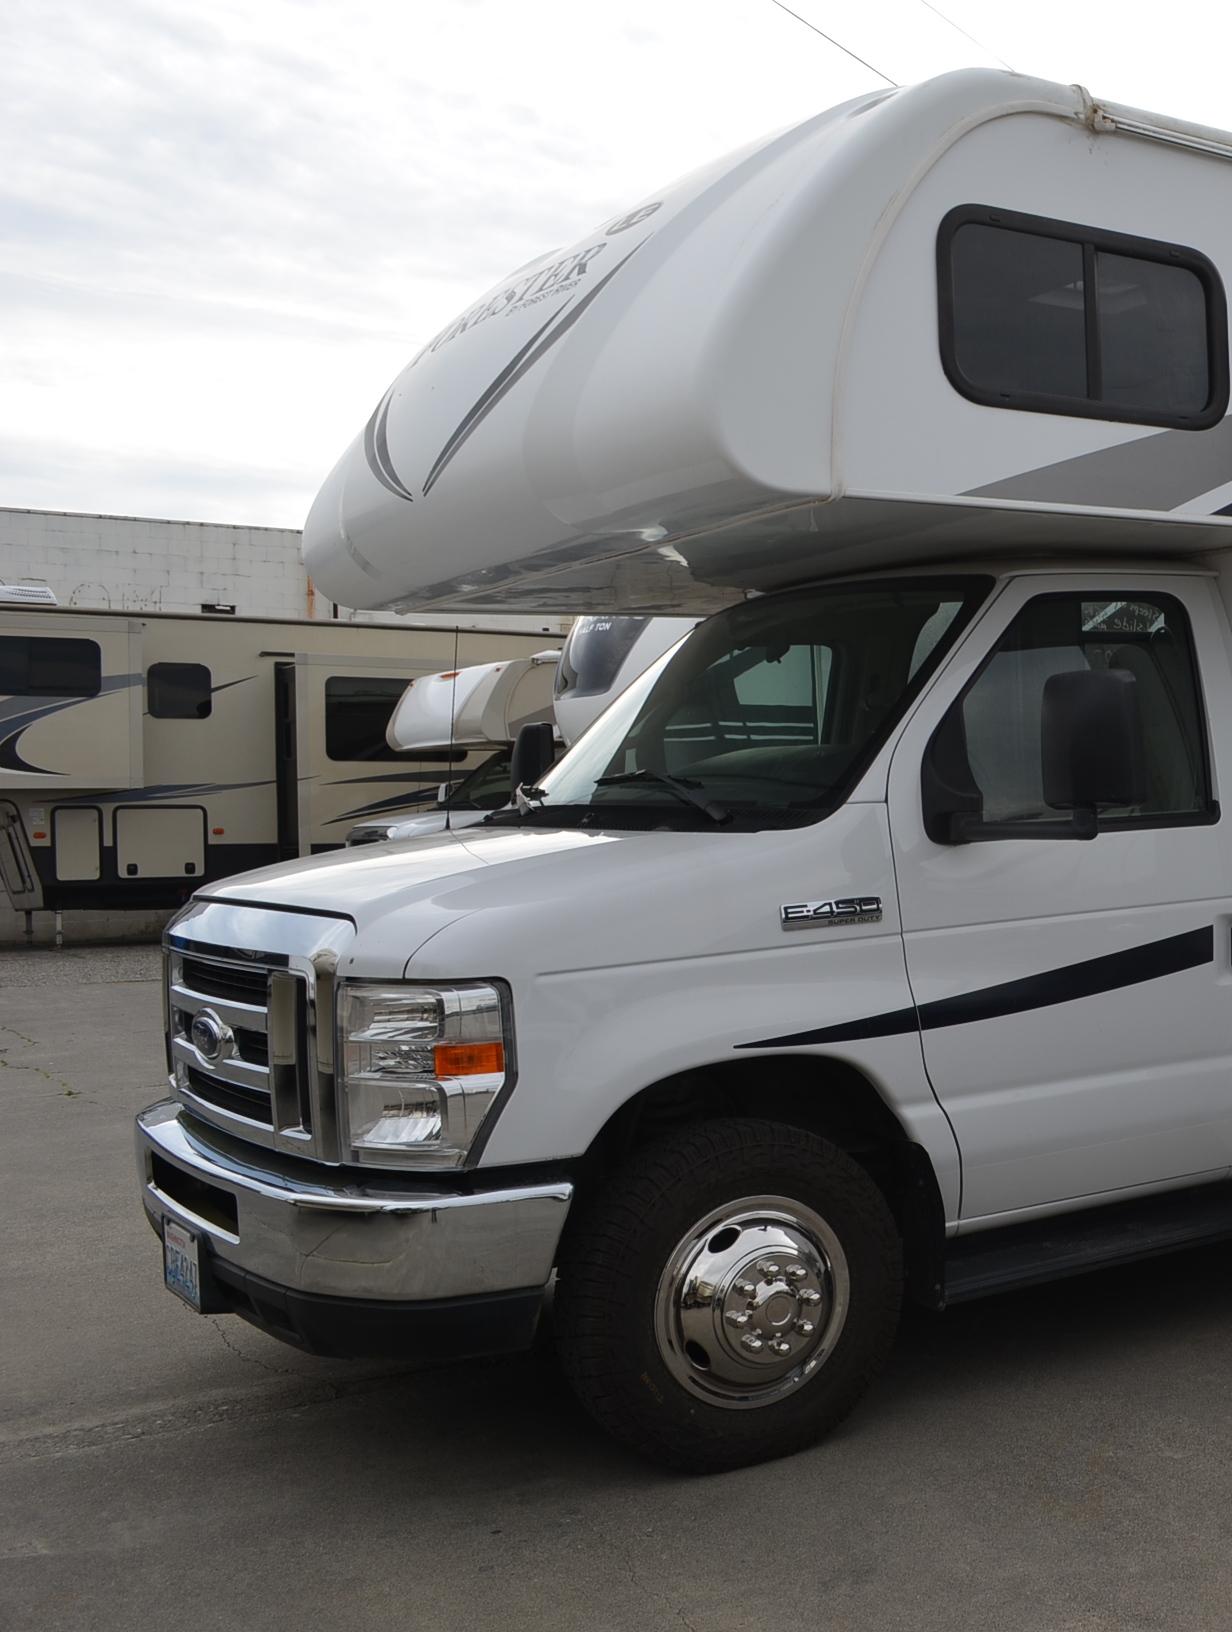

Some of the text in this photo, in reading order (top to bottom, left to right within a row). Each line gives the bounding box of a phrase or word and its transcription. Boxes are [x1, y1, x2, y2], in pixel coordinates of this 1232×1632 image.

[595, 622, 612, 632] TON
[782, 897, 881, 921] E-450
[827, 914, 880, 925] SUPER DUTY
